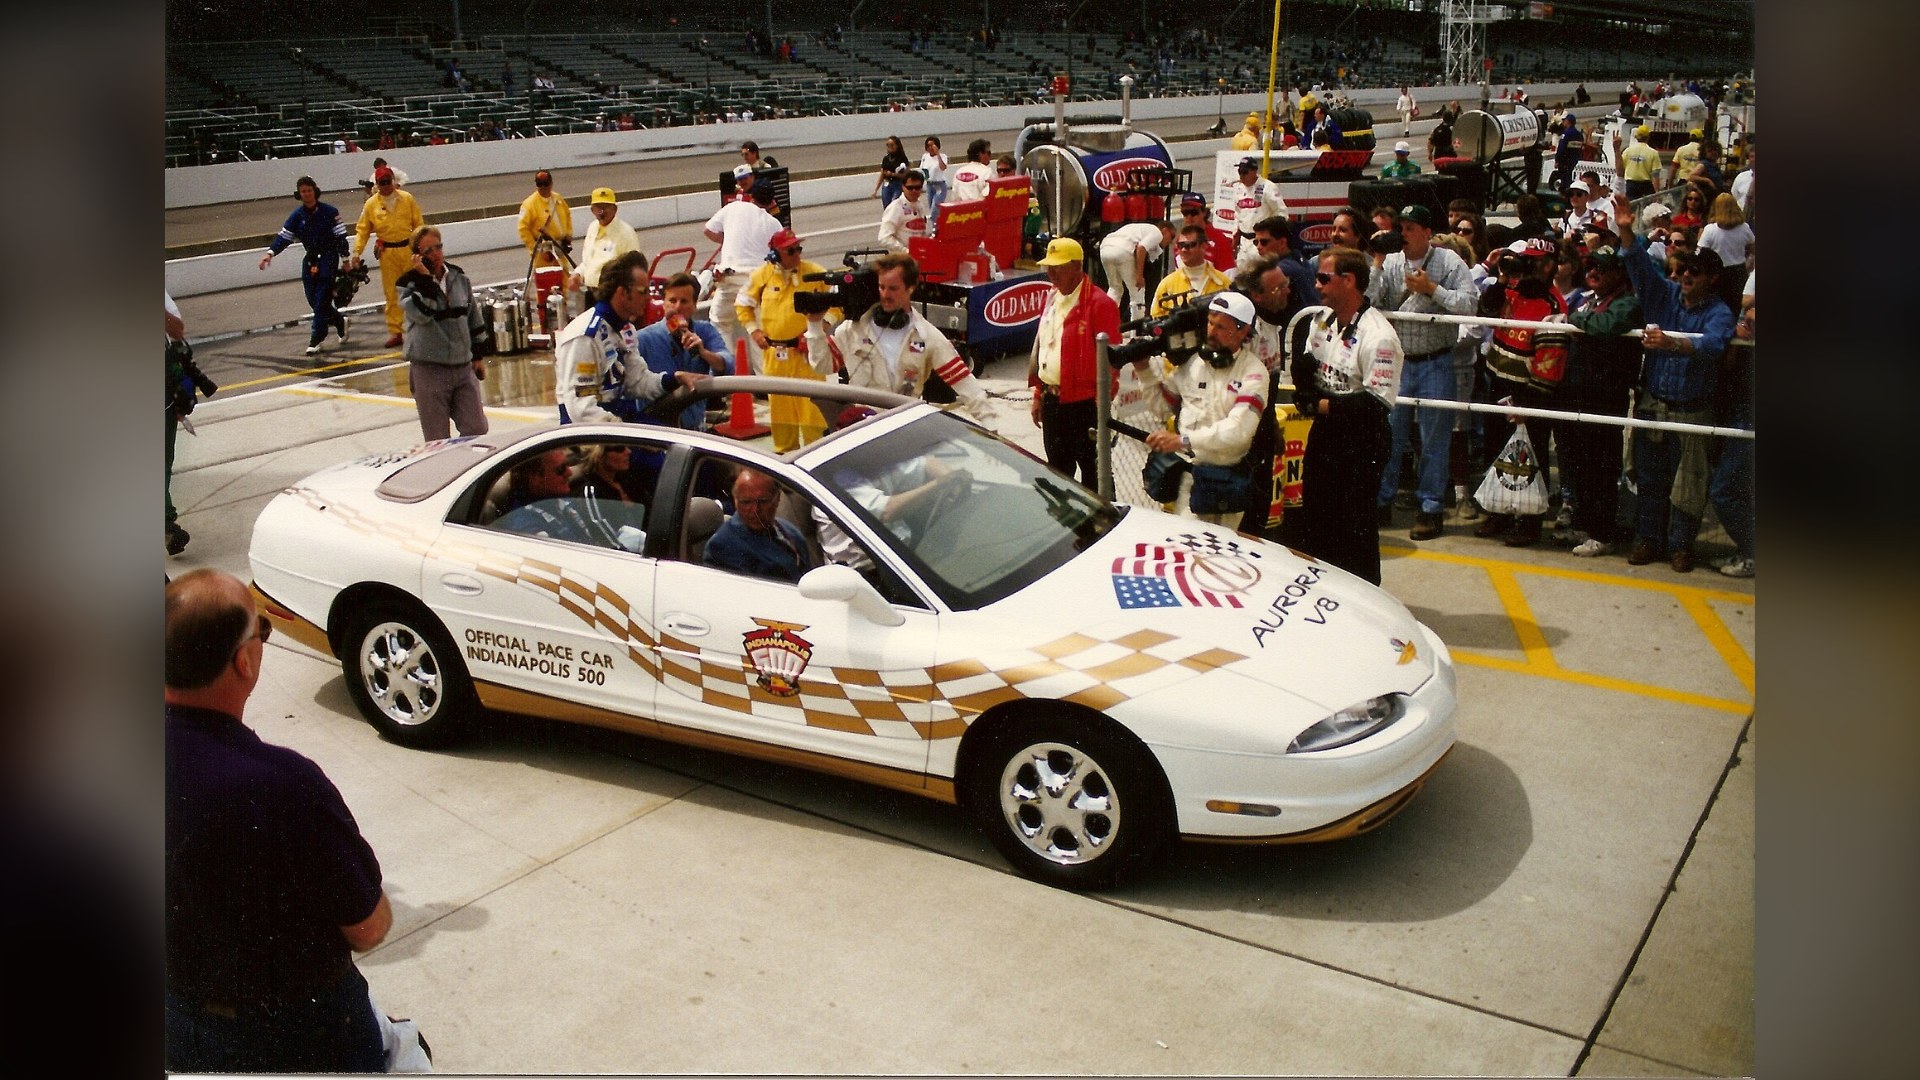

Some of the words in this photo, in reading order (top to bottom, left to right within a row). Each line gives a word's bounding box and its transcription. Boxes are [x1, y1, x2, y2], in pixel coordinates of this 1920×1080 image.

[1100, 169, 1126, 187] OLD
[995, 187, 1028, 199] Snap-on
[946, 211, 983, 224] Snap-on
[1303, 230, 1320, 240] OLD
[1321, 229, 1333, 240] NA
[992, 297, 1017, 320] OLD
[1252, 565, 1327, 648] AURORA
[1304, 596, 1340, 626] V8
[465, 628, 530, 653] OFFICIAL
[537, 641, 573, 661] PACE
[581, 650, 614, 669] CAR
[746, 637, 810, 660] INDIANAPOLIS
[467, 645, 570, 678] INDIANAPOLIS
[578, 666, 605, 686] 500
